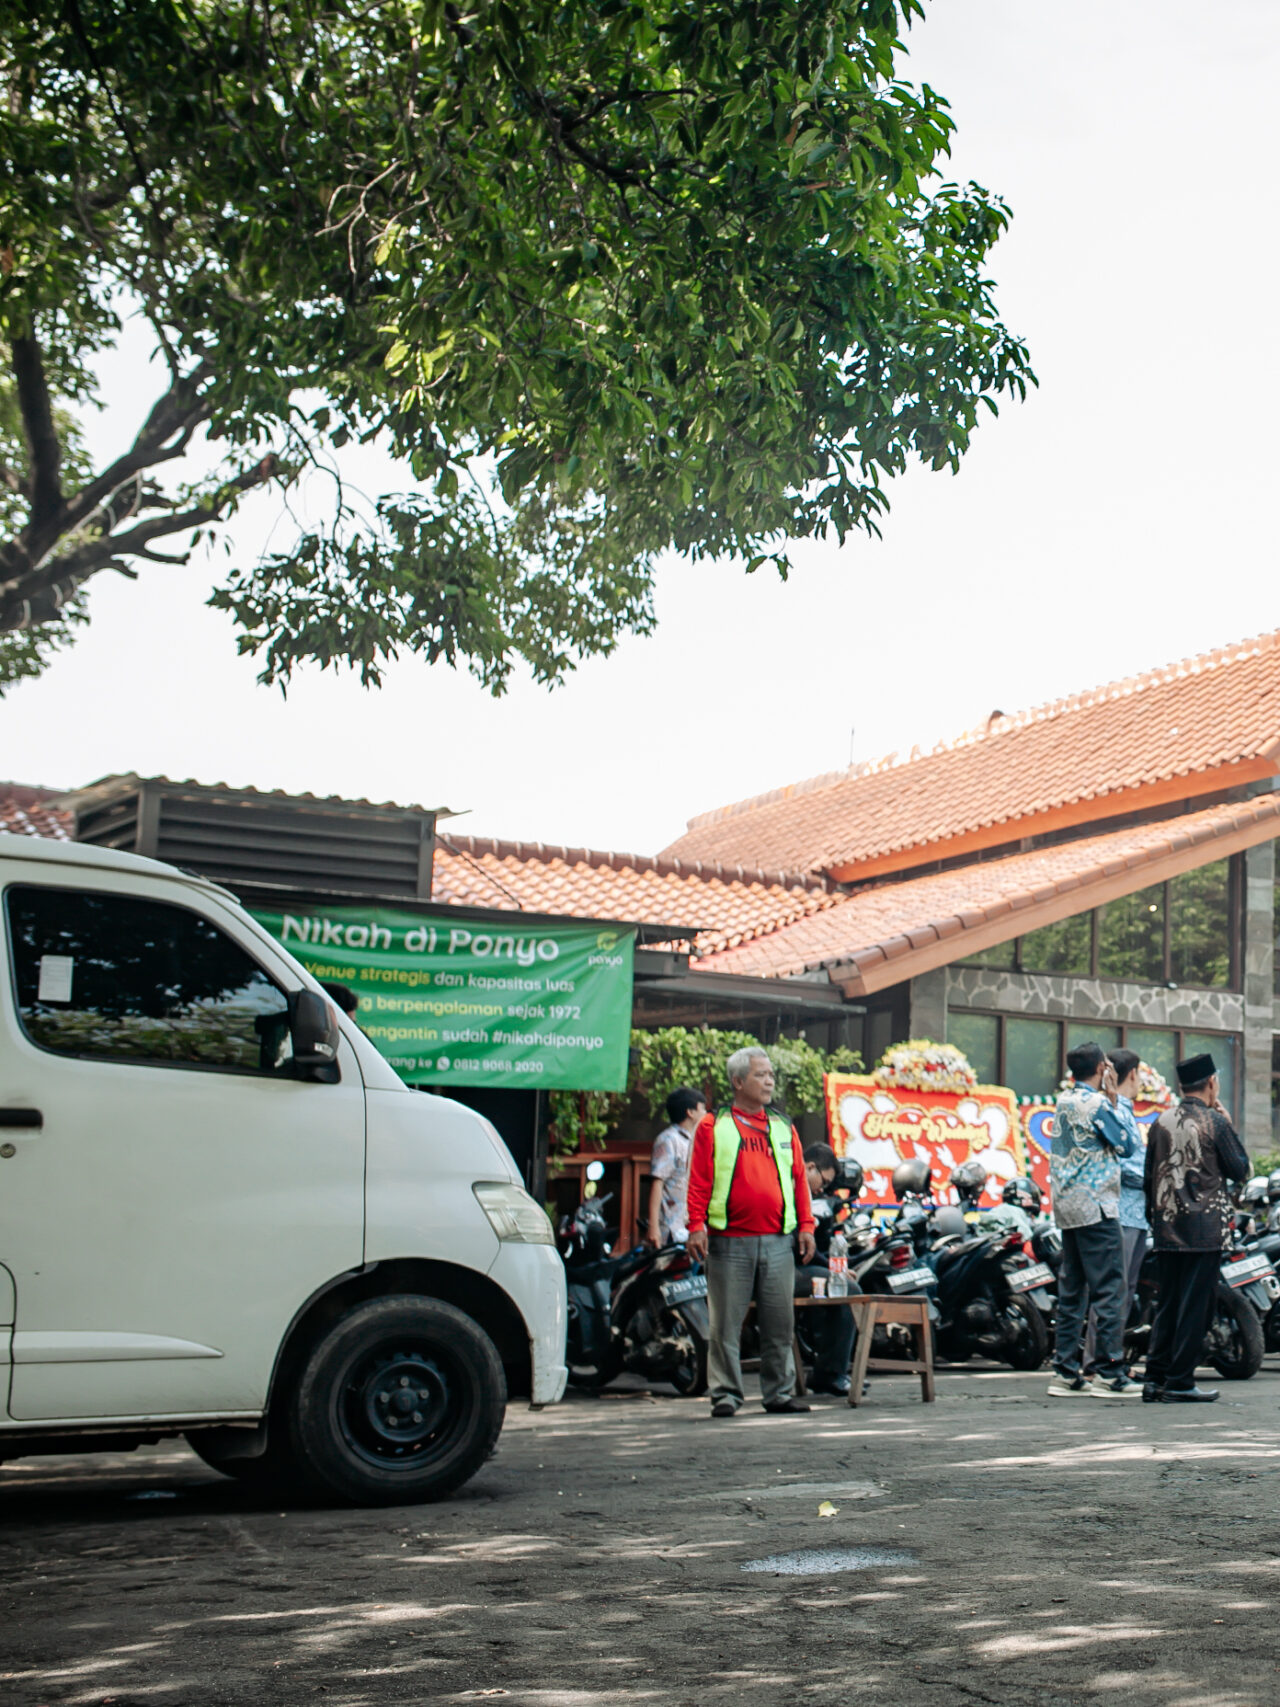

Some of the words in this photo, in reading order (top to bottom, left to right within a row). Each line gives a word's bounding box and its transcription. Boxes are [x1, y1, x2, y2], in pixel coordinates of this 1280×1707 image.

[281, 914, 392, 950] Nikah
[404, 926, 437, 953] di
[448, 929, 560, 966] Ponyo
[305, 962, 356, 979] Venue
[360, 968, 430, 986] strategis
[434, 972, 464, 987] dan
[468, 974, 542, 990] kapasitas
[546, 979, 575, 992] luas
[376, 995, 503, 1016] berpengalaman
[507, 1004, 545, 1020] sejak
[549, 1005, 581, 1019] 1972
[442, 1028, 488, 1043] sudah
[492, 1030, 604, 1050] #nikahdiponyo
[418, 1057, 432, 1069] ke
[453, 1059, 479, 1070] 0812
[514, 1061, 544, 1073] 2020
